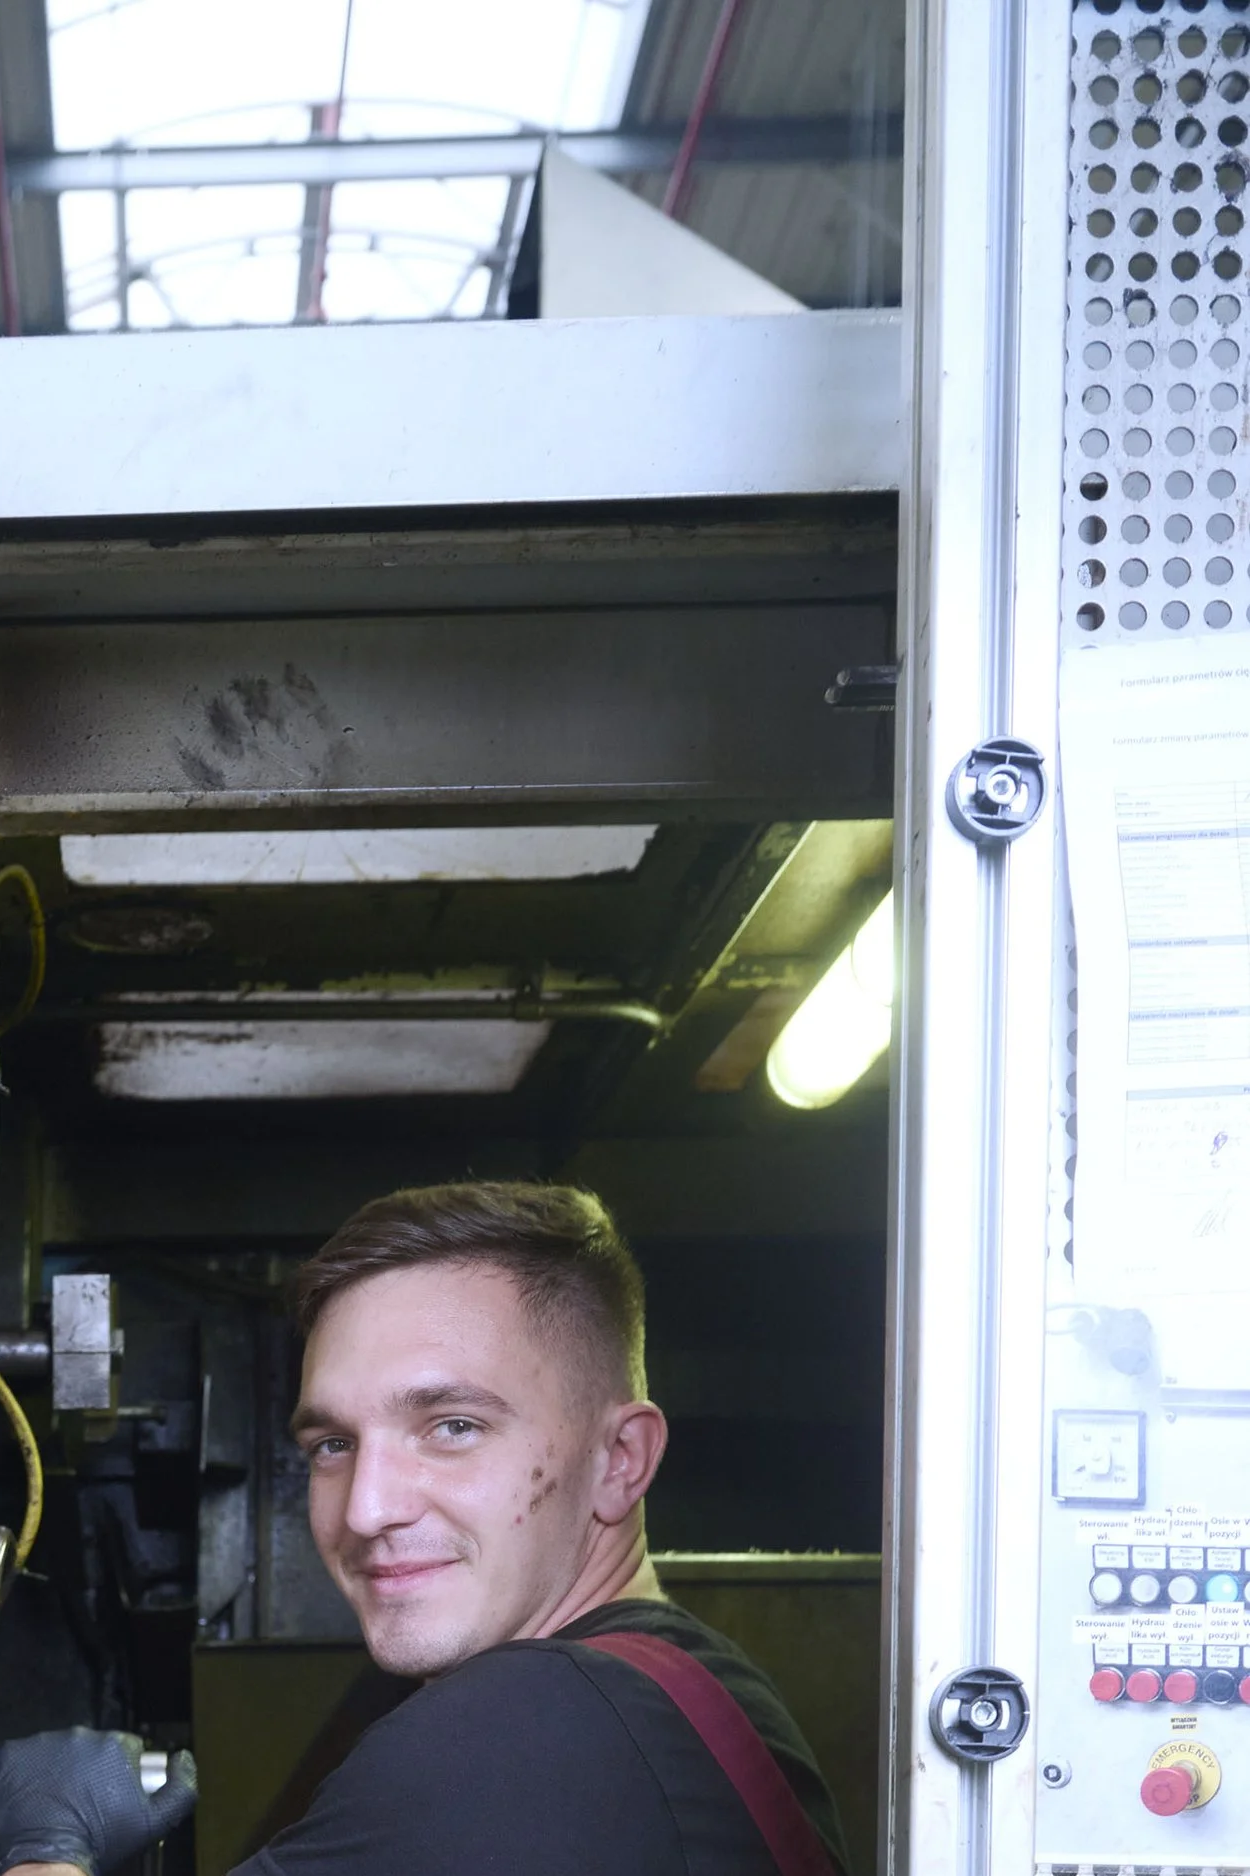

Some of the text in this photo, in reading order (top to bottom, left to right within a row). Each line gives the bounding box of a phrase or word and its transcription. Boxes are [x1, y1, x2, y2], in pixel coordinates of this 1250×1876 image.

[1120, 675, 1169, 688] Formularz
[1172, 668, 1233, 684] parametrów
[1079, 1519, 1129, 1528] Sterowanie
[1174, 1519, 1203, 1527] dzenie
[1211, 1516, 1230, 1525] Osie
[1209, 1529, 1241, 1540] pozycji
[1211, 1606, 1240, 1614] Ustaw
[1075, 1619, 1126, 1628] Sterowanie
[1173, 1620, 1202, 1629] dzenie
[1210, 1619, 1229, 1627] osie
[1131, 1630, 1148, 1639] lika
[1208, 1631, 1241, 1641] pozycji
[1151, 1743, 1215, 1769] EMERGENCY
